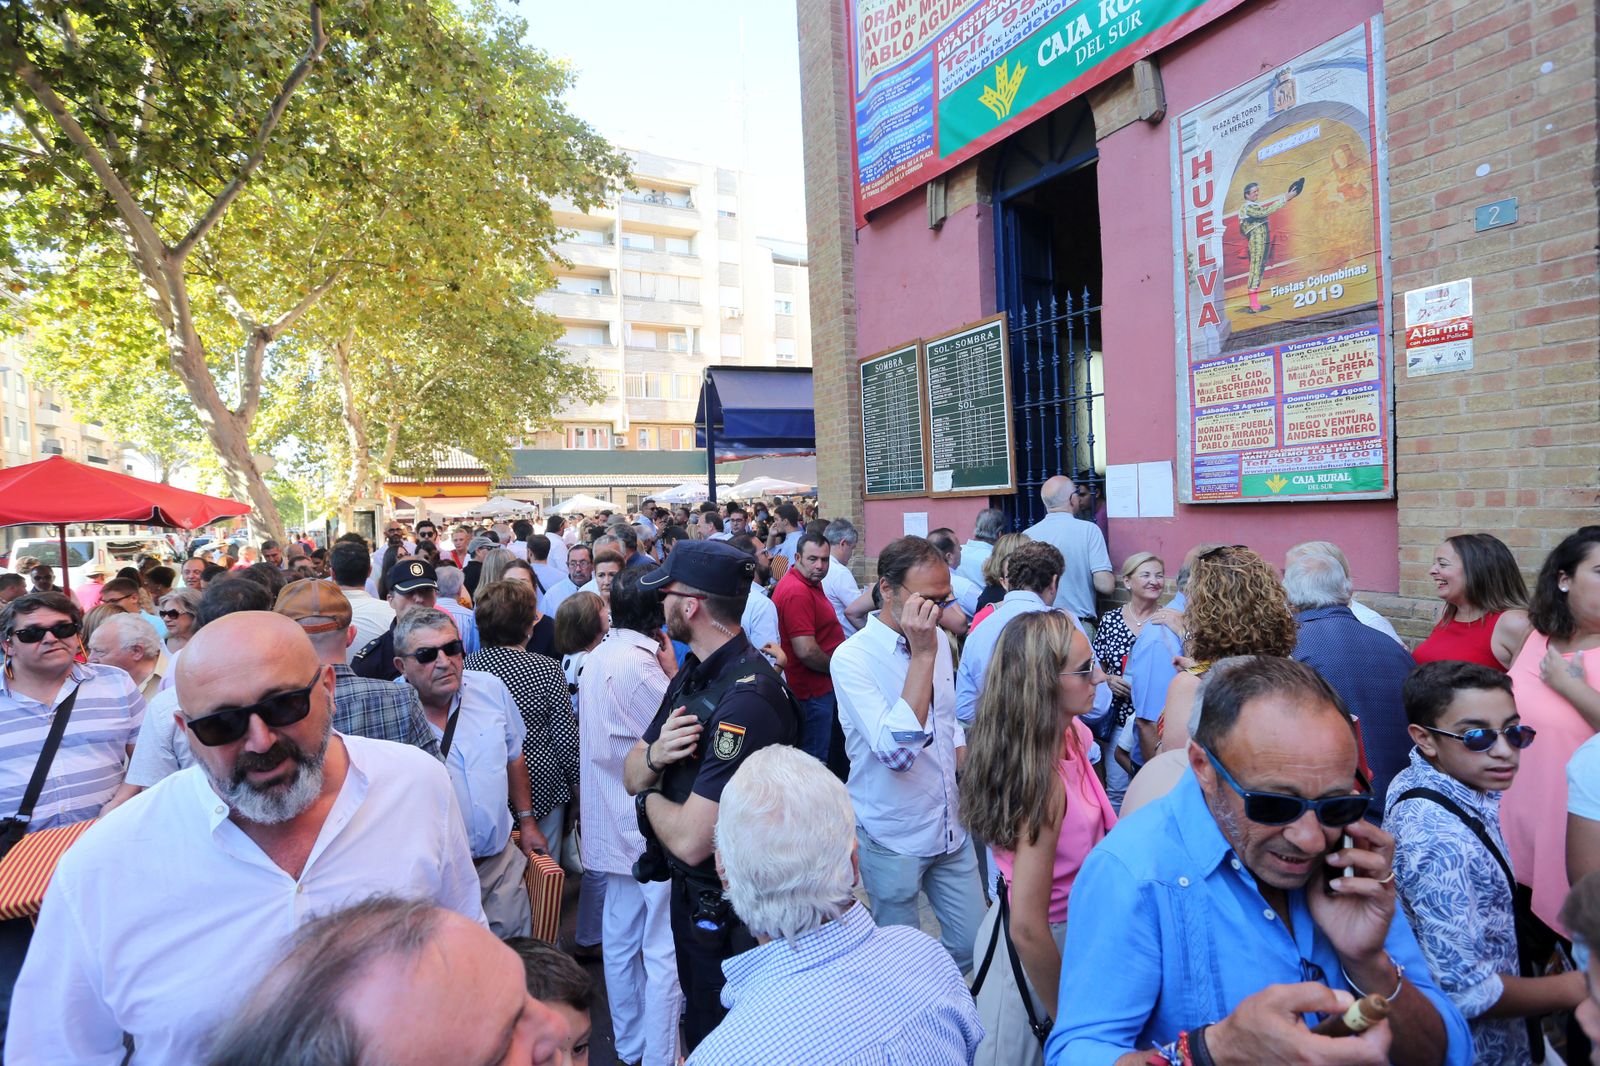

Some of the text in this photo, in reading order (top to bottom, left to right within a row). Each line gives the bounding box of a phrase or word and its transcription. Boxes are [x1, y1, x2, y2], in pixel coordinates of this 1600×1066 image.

[904, 14, 917, 30] de
[938, 31, 955, 51] LOS
[1037, 13, 1093, 67] CAJA
[1075, 10, 1143, 66] DEL SUR
[942, 66, 963, 85] VENTA
[963, 44, 992, 69] ONLINE
[992, 34, 1004, 47] DE
[1212, 104, 1262, 131] PLAZA DE TOROS
[1221, 118, 1254, 138] LA MERCED
[1488, 205, 1501, 226] 2
[1191, 150, 1221, 328] HUELVA
[1271, 264, 1368, 297] Fiestas Colombinas
[1293, 283, 1344, 309] 2019
[1410, 323, 1468, 340] Alarma
[1288, 340, 1324, 351] Viernes,
[1337, 330, 1370, 342] Agosto
[1306, 345, 1337, 354] Corrida
[1352, 337, 1376, 345] Toros
[875, 356, 904, 373] SOMBRA
[1200, 359, 1228, 369] Jueves,
[1238, 351, 1266, 362] Agosto
[1321, 357, 1336, 366] EL
[1340, 350, 1368, 363] JULI
[1328, 358, 1374, 374] PERERA
[1213, 364, 1239, 372] Corrida
[1231, 374, 1243, 382] EL
[1245, 370, 1263, 380] CID
[1216, 377, 1272, 393] ESCRIBANO
[1299, 370, 1362, 388] ROCA REY
[1200, 386, 1270, 403] RAFAEL SERNA
[1287, 393, 1328, 403] Domingo,
[1341, 385, 1373, 395] Agosto
[1305, 399, 1333, 407] Corrida
[1345, 393, 1375, 401] Rejones
[958, 401, 975, 411] SOL
[1241, 401, 1269, 410] Agosto
[1197, 424, 1235, 434] MORANTE
[1241, 418, 1274, 430] PUEBLA
[1288, 412, 1374, 432] DIEGO VENTURA
[1197, 433, 1223, 443] DAVID
[1232, 427, 1274, 440] MIRANDA
[1286, 422, 1377, 441] ANDRES ROMERO
[1201, 436, 1269, 450] PABLO AGUADO
[1242, 449, 1309, 460] MANTENEMOS
[1335, 443, 1382, 453] PRECIOS
[1307, 454, 1325, 462] 28
[1331, 452, 1347, 460] 15
[1351, 450, 1370, 458] 00
[1292, 472, 1352, 485] CAJA RURAL
